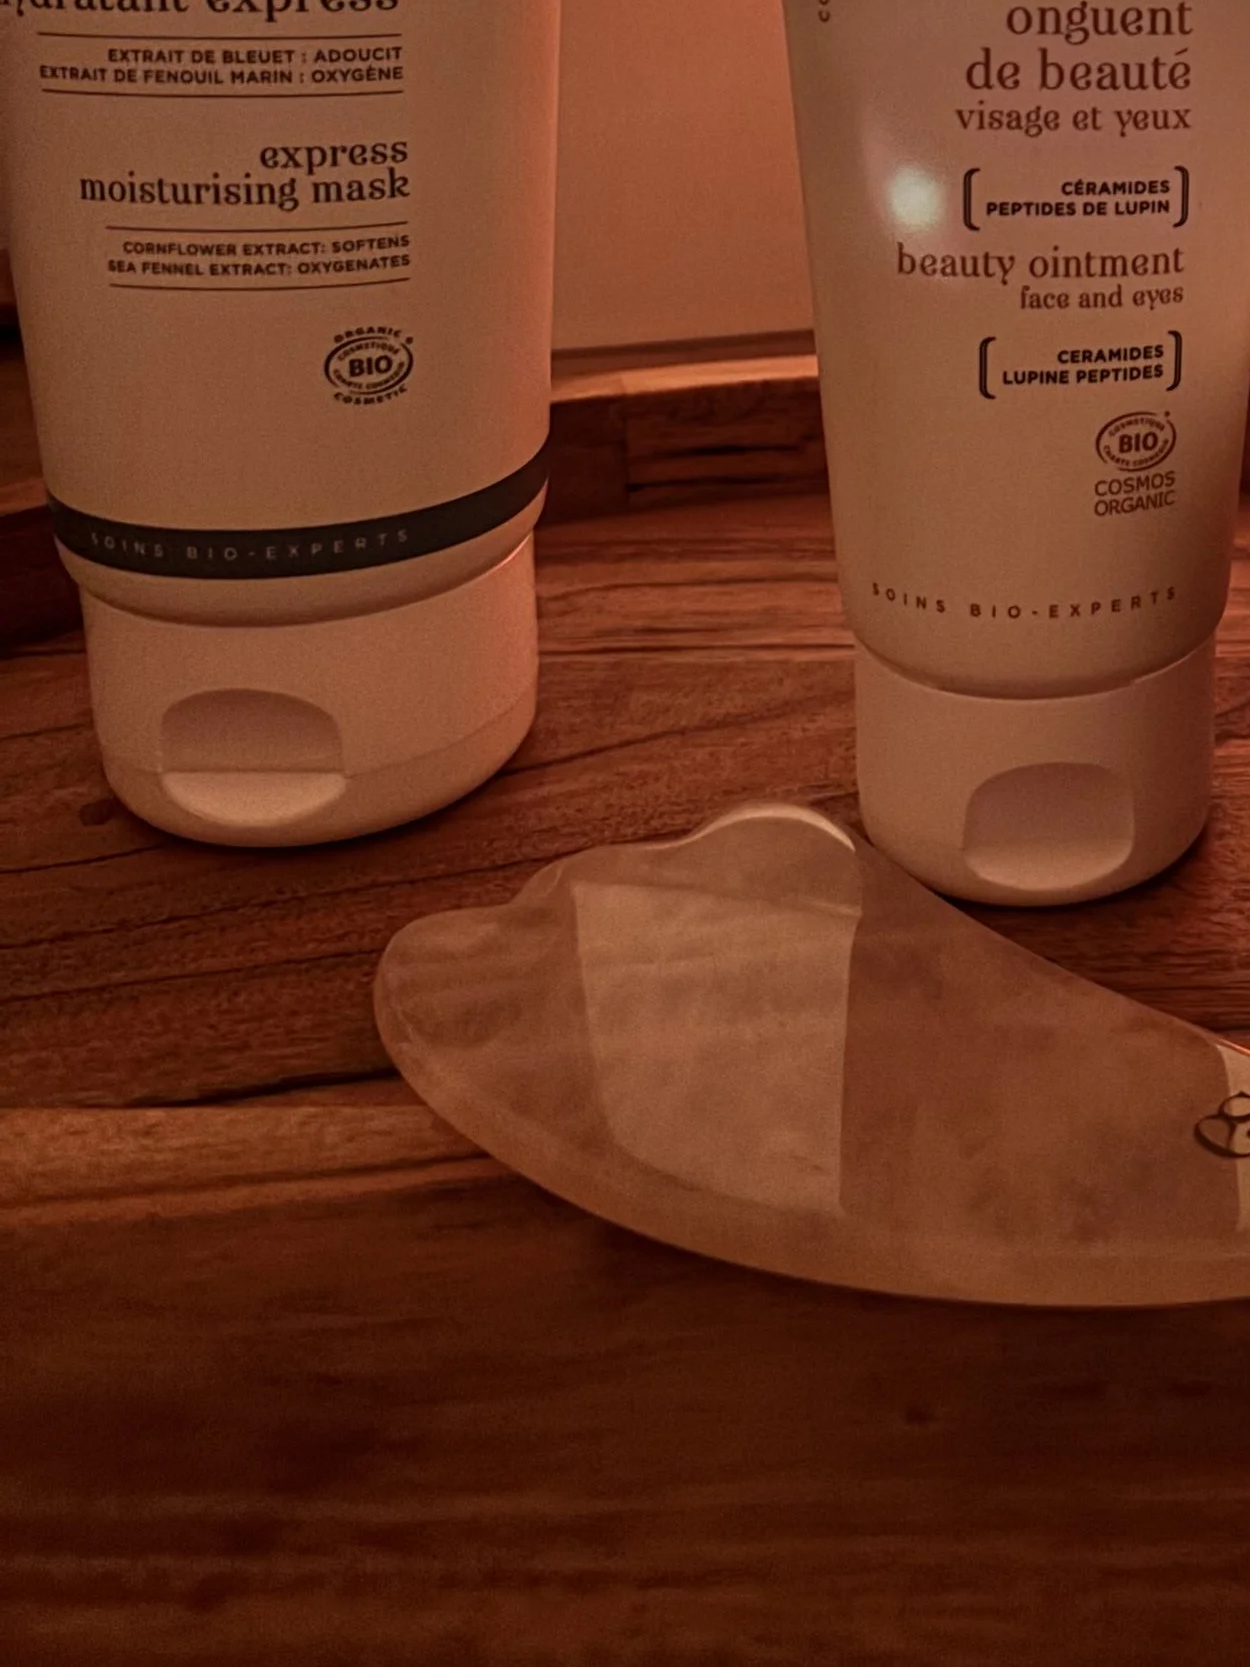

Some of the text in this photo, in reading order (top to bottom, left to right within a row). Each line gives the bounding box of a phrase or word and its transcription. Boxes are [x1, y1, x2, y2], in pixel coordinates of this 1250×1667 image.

[1006, 0, 1193, 44] onguent
[107, 48, 185, 64] EXTRAIT
[190, 49, 217, 65] DE
[221, 49, 296, 65] BLEUET
[313, 46, 403, 64] ADOUCIT
[965, 46, 1191, 91] de beauté
[39, 64, 108, 82] EXTRAIT
[113, 68, 137, 84] DE
[142, 68, 224, 85] FENOUIL
[230, 69, 293, 85] MARIN
[955, 99, 1191, 138] visage et yeux
[259, 141, 409, 175] express
[79, 168, 411, 213] moisturising mask
[1060, 178, 1171, 197] CÉRAMIDES
[986, 199, 1170, 217] PEPTIDES DE LUPIN
[122, 240, 237, 257] CORNFLOWER
[331, 234, 411, 254] SOFTENS
[107, 259, 137, 274] SEA
[141, 261, 205, 277] FENNEL
[297, 254, 411, 275] OXYGENATES
[897, 241, 1184, 287] beauty ointment
[1020, 283, 1184, 311] face and eyes
[348, 355, 393, 377] BIO
[1056, 344, 1165, 367] CERAMIDES
[1002, 363, 1164, 386] LUPINE PEPTIDES
[1118, 431, 1159, 454] BIO
[1094, 470, 1176, 497] COSMOS
[1094, 489, 1176, 517] ORGANIC
[90, 529, 409, 562] SOINS BIO-EXPERTS
[871, 582, 1177, 620] SOINS BIO-EXPERTS
